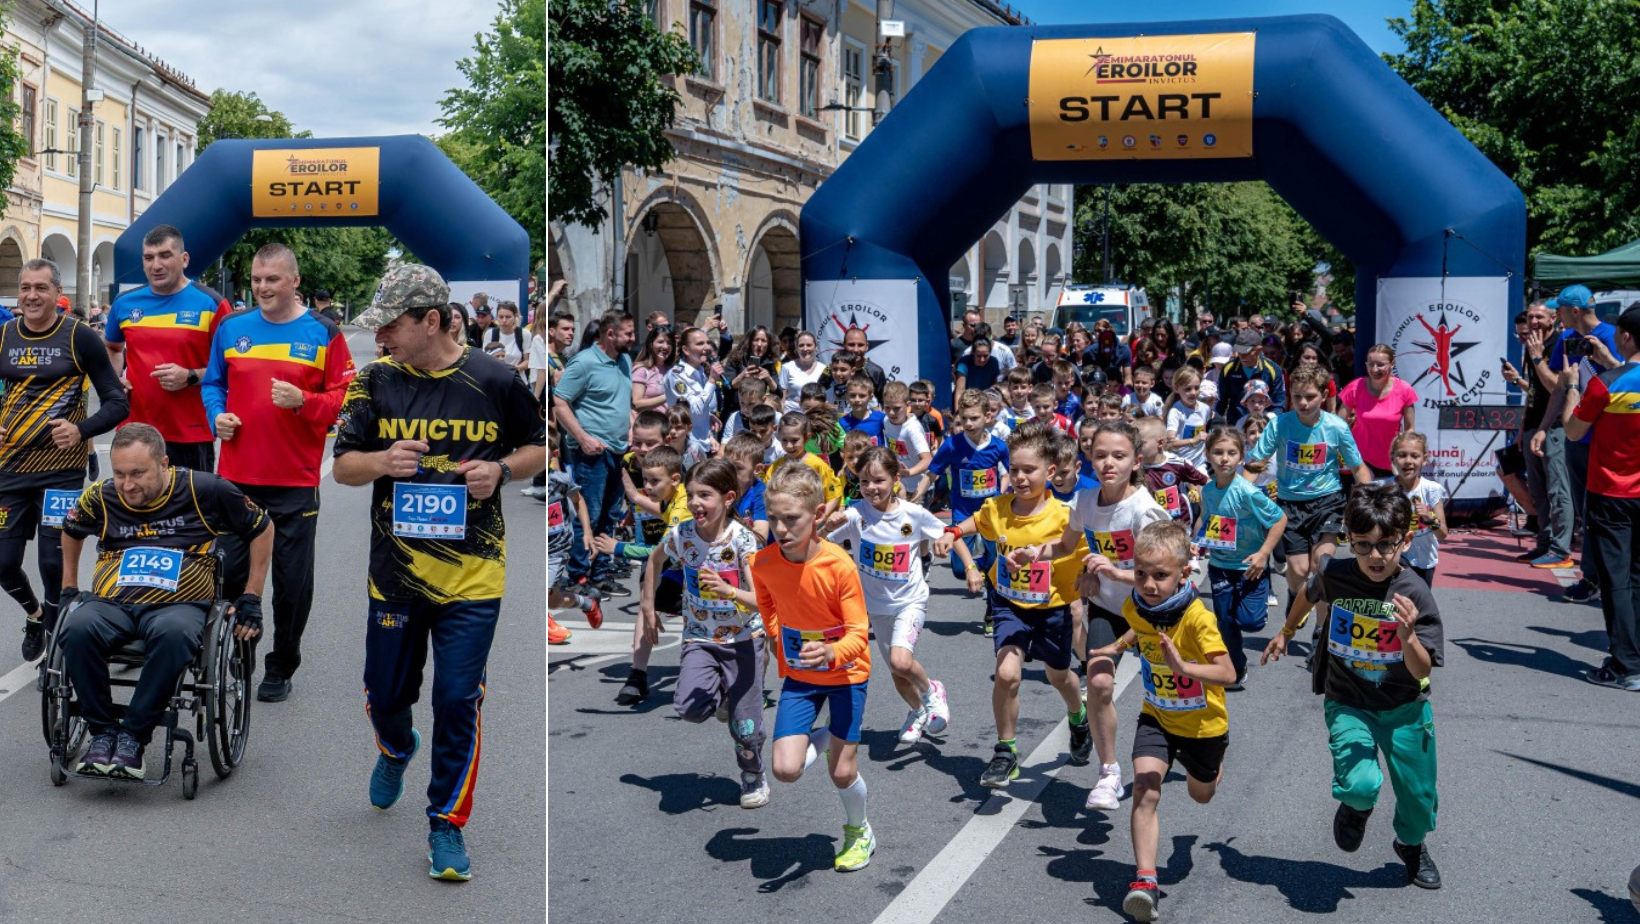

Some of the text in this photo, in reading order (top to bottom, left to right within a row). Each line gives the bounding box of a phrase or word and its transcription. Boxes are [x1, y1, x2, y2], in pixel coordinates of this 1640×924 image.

[1097, 54, 1197, 64] SEMIMARATONUL
[1097, 61, 1198, 79] EROILOR
[1059, 92, 1221, 123] START
[290, 163, 348, 173] EROILOR
[269, 181, 361, 196] START
[841, 304, 888, 323] EROILOR
[1429, 303, 1480, 324] EROILOR
[8, 347, 61, 357] INVICTUS
[10, 356, 52, 365] GAMES
[1453, 410, 1516, 429] 13:32
[1291, 447, 1322, 460] 3147
[963, 474, 994, 486] 3264
[401, 493, 457, 515] 2190
[120, 516, 185, 535] INVICTUS
[127, 554, 173, 571] 2149
[863, 547, 906, 565] 3087
[1001, 564, 1044, 583] 3037
[1335, 616, 1397, 644] 3047
[1144, 665, 1193, 690] 3030
